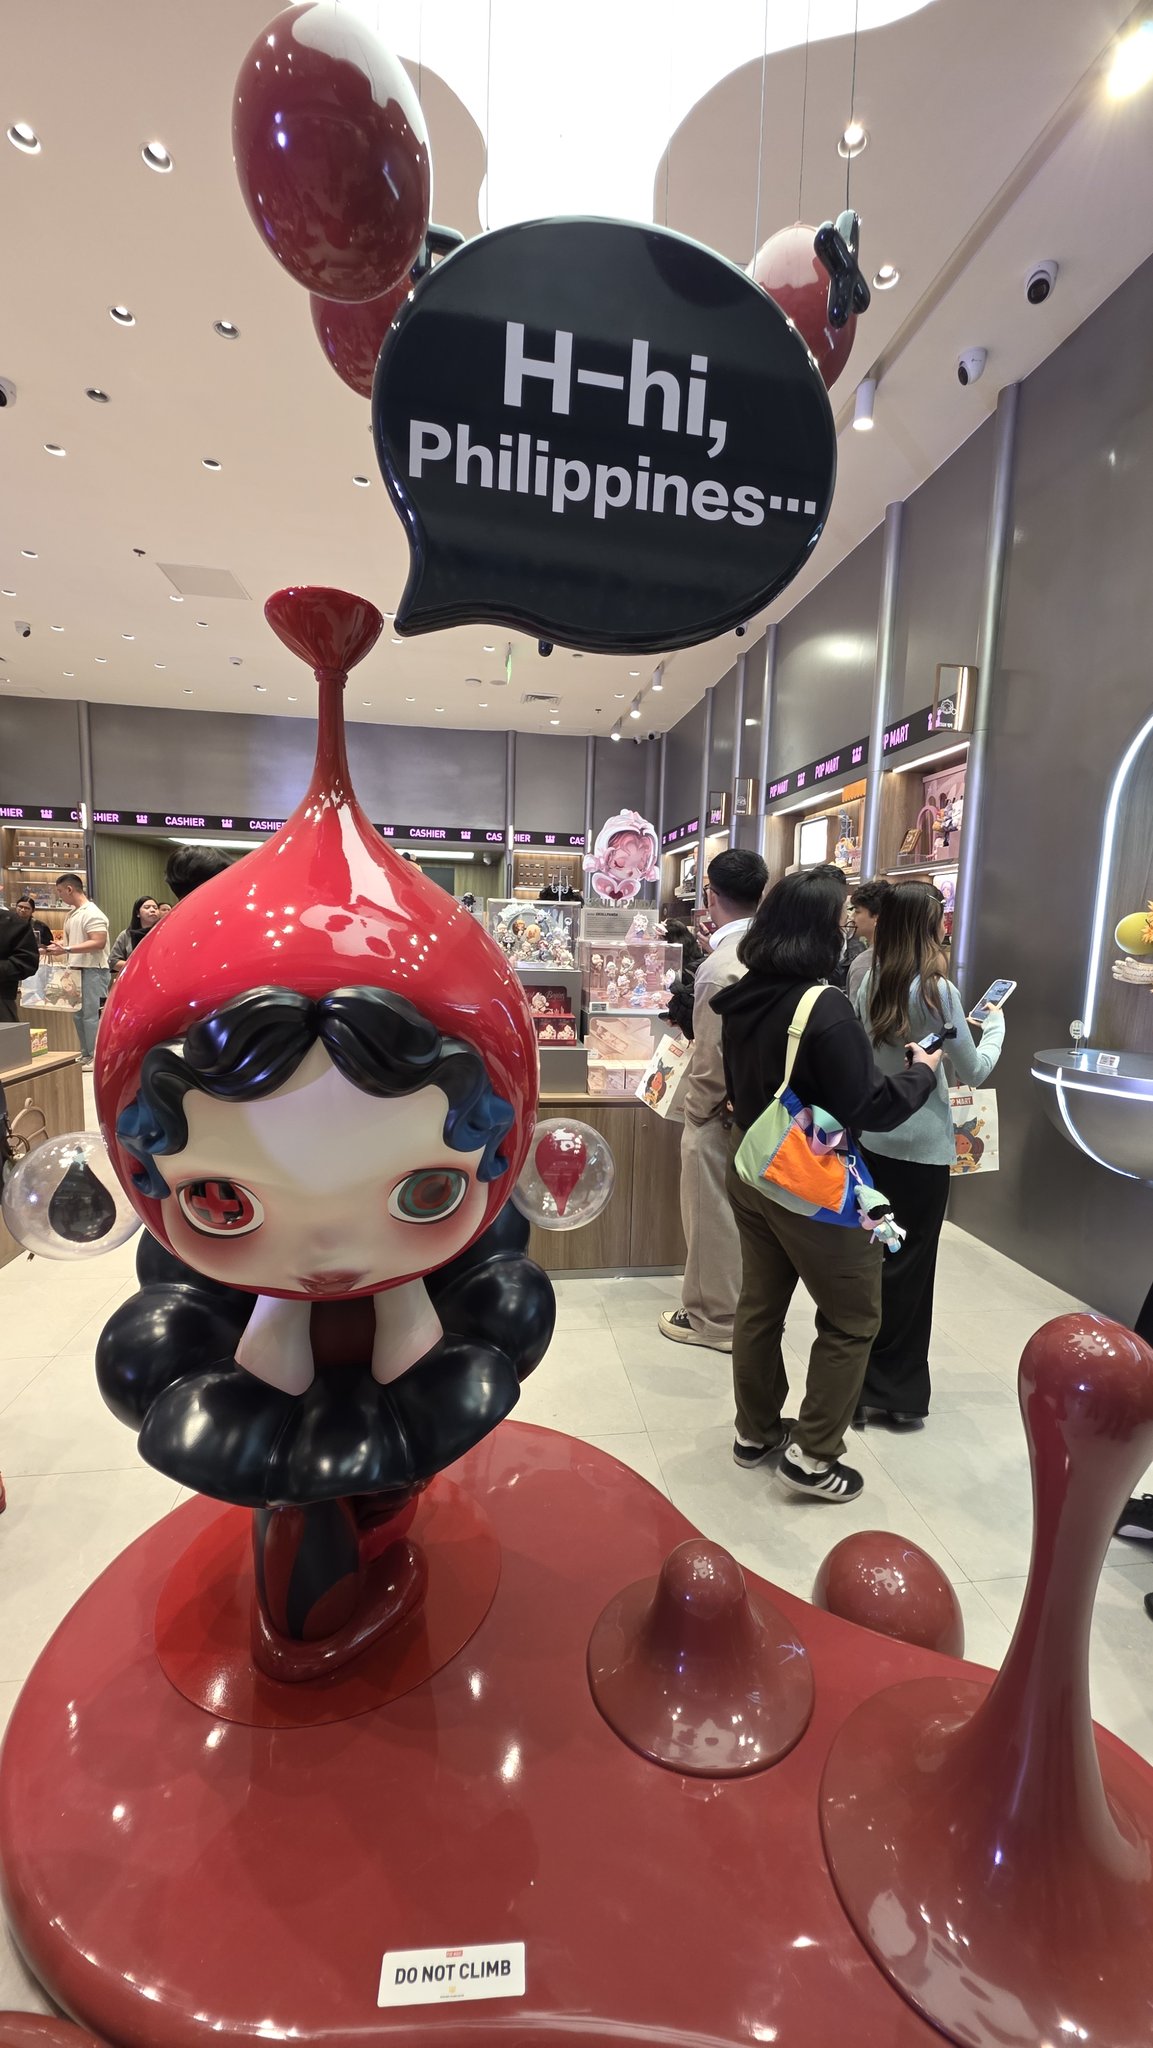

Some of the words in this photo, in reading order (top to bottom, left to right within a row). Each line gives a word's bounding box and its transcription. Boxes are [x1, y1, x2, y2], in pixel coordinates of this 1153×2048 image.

[889, 723, 910, 748] MART
[814, 763, 825, 780] POP
[825, 755, 840, 776] MART
[0, 807, 23, 818] HIER
[165, 816, 205, 827] CASHIER
[249, 820, 284, 831] CASHIE
[409, 828, 446, 839] CASHIER
[395, 1967, 418, 1985] DO
[421, 1964, 456, 1983] NOT
[459, 1960, 511, 1979] CLIMB
